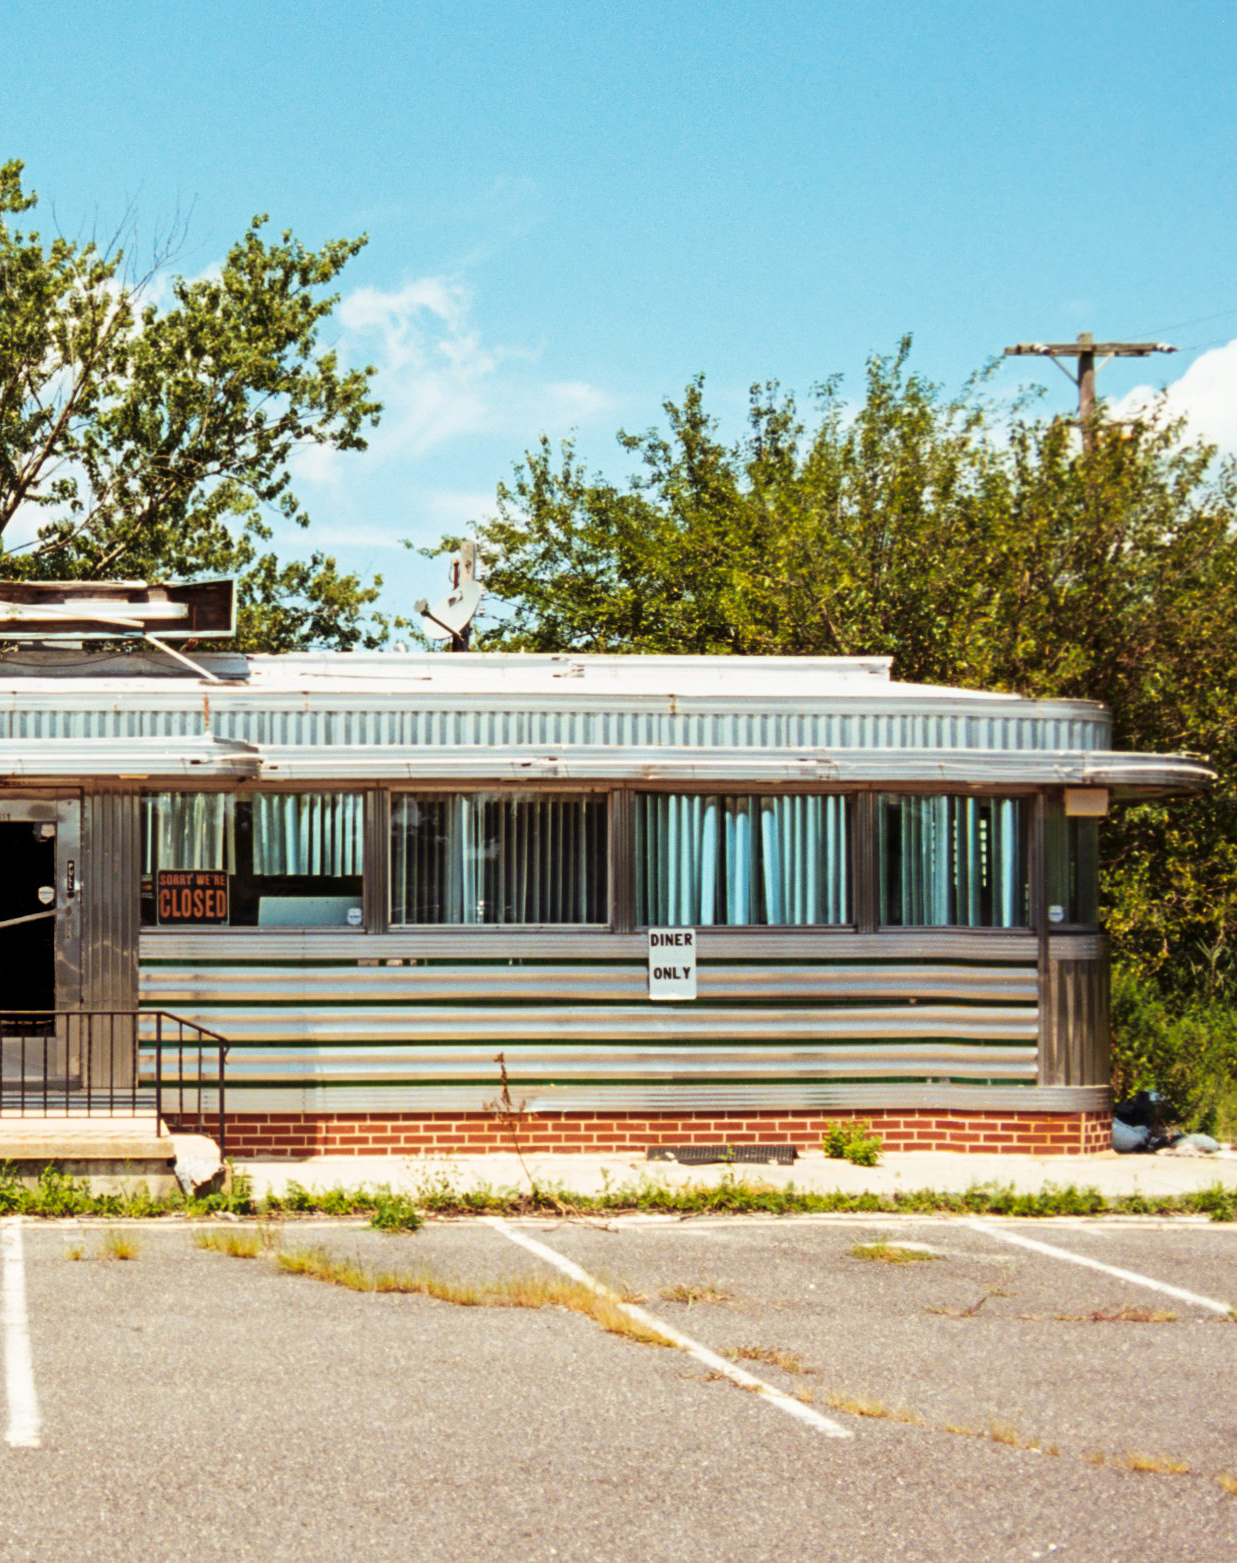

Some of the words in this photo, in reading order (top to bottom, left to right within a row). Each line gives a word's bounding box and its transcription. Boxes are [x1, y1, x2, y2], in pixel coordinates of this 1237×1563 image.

[160, 874, 192, 886] SORRY
[196, 874, 226, 886] WE'RE
[160, 889, 226, 918] CLOSED
[650, 933, 693, 947] DINER
[653, 966, 691, 980] ONLY
